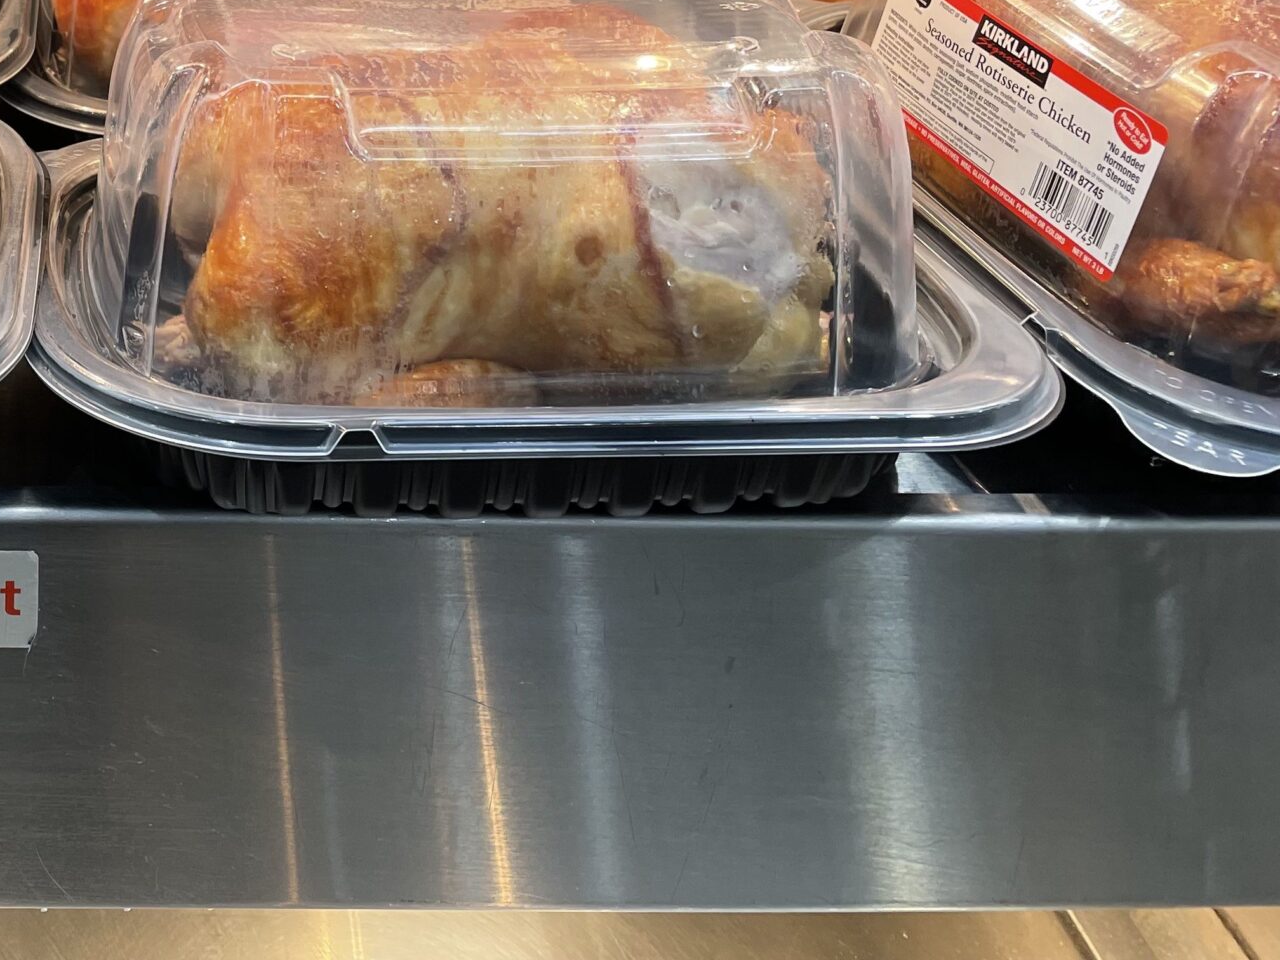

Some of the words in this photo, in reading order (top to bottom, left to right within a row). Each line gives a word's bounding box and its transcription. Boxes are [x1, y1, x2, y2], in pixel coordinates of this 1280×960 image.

[975, 35, 1042, 81] Signature
[980, 19, 1049, 74] KIRKLAND
[924, 17, 975, 63] Seasoned
[975, 54, 1035, 104] Rotisserie
[1038, 96, 1091, 144] Chicken
[1056, 159, 1079, 182] ITEM
[1078, 175, 1105, 201] 87745
[1096, 163, 1106, 172] or
[1105, 168, 1136, 195] Steroids
[1103, 152, 1141, 184] Hormones
[1120, 150, 1146, 173] Added
[1019, 186, 1025, 196] 0
[1034, 197, 1063, 224] 23700
[1064, 219, 1094, 246] 87745
[1071, 245, 1082, 259] NET
[1095, 264, 1104, 275] LB
